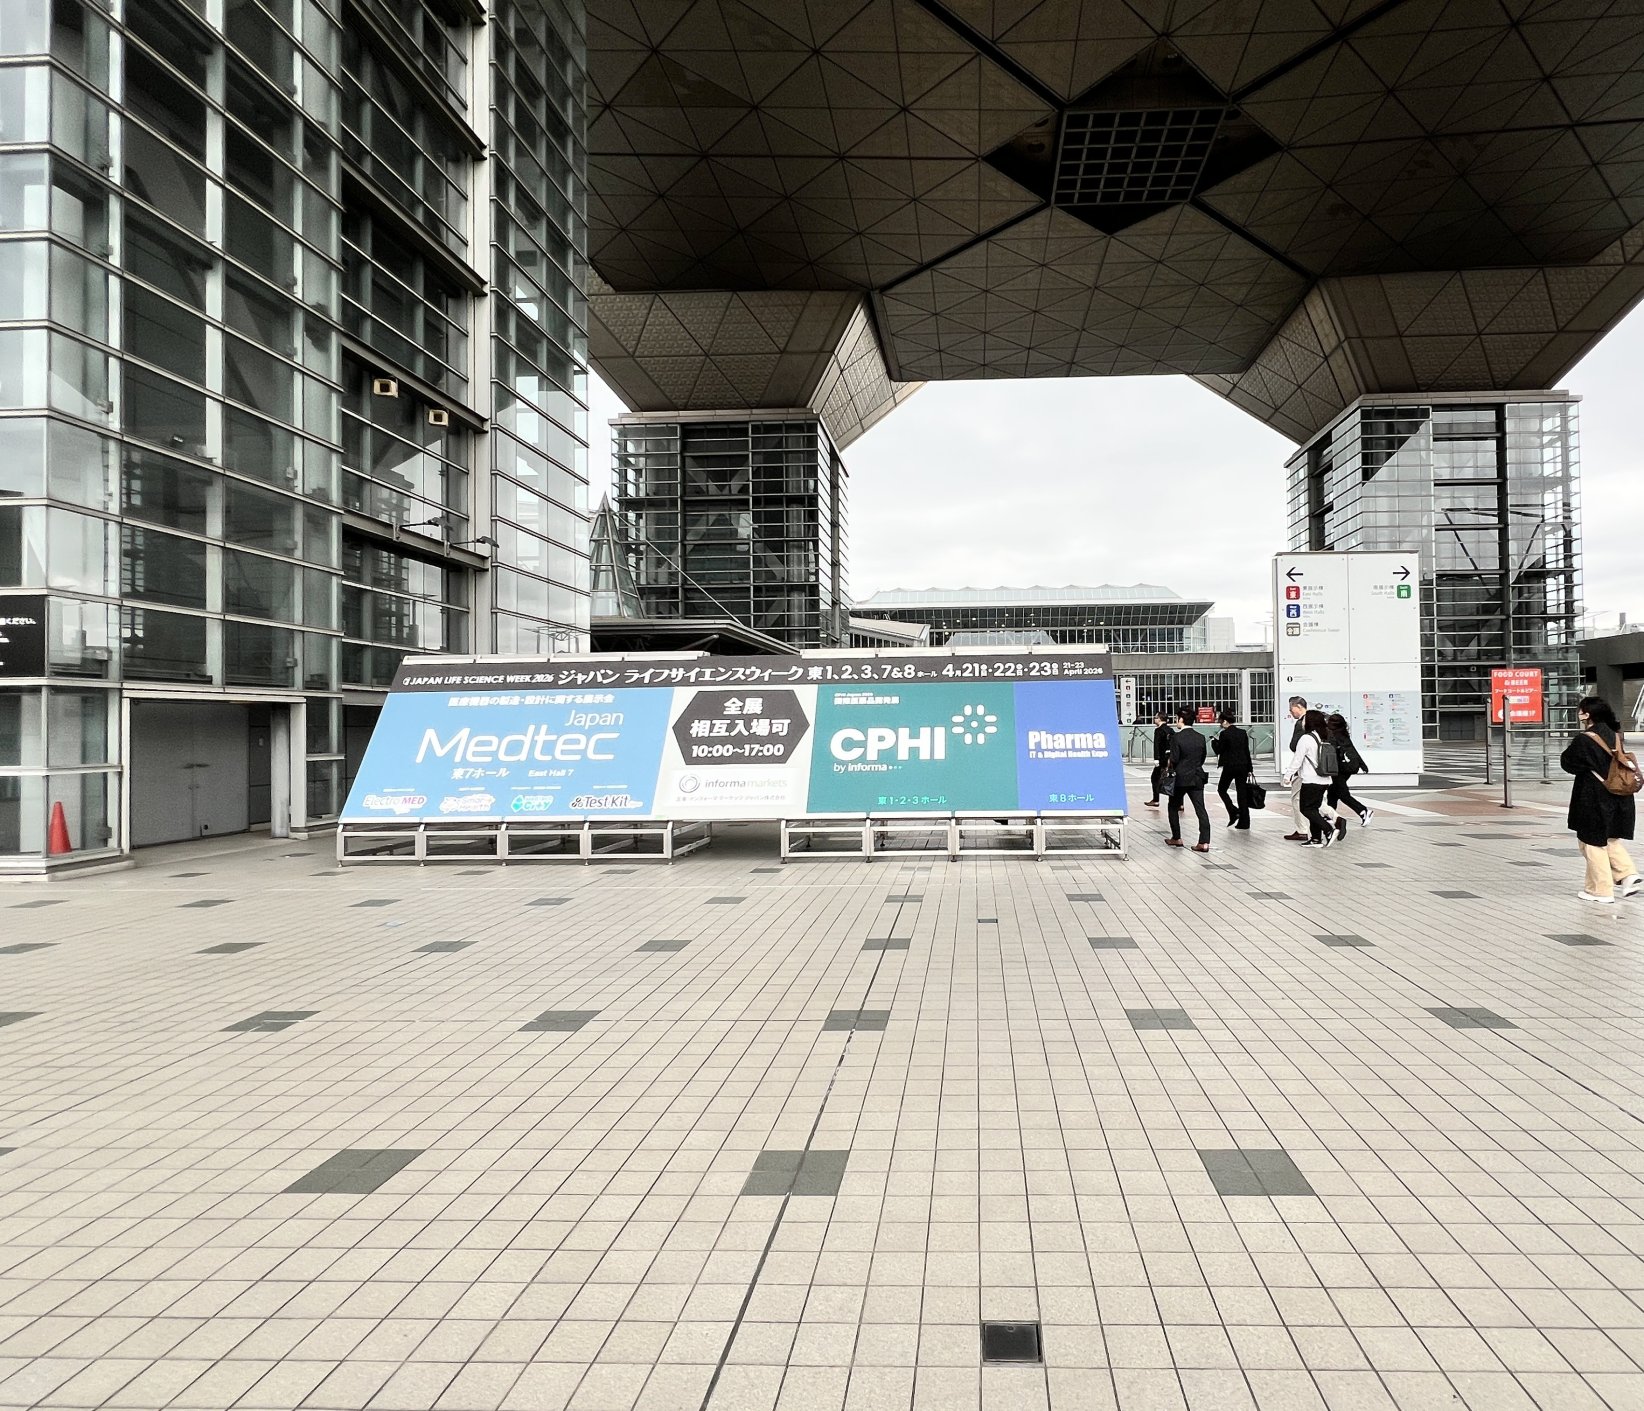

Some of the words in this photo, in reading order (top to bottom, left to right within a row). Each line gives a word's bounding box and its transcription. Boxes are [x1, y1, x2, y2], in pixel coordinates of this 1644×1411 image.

[1062, 661, 1085, 669] 21-23
[1063, 668, 1083, 676] April
[1084, 667, 1104, 675] 2026
[410, 676, 442, 686] JAPAN
[444, 675, 462, 685] LIFE
[463, 675, 504, 685] SCIENCE
[506, 674, 532, 684] WEEK
[532, 673, 555, 683] 2026
[558, 669, 620, 685] ジャパン
[623, 666, 804, 684] ライフサイエンスウィーク
[723, 697, 764, 715] 全展
[564, 709, 625, 730] Japan
[689, 718, 792, 738] 相互入場可
[415, 724, 621, 764] Medtec
[830, 726, 946, 761] CPHI
[1028, 730, 1106, 750] Pharma
[1029, 751, 1036, 759] IT
[452, 767, 510, 780] 東7ホール
[528, 769, 548, 777] East
[549, 768, 566, 777] Hall
[567, 768, 574, 776] 7
[833, 763, 847, 774] by
[848, 763, 887, 772] informa
[585, 796, 608, 808] Test
[610, 794, 628, 808] Kit
